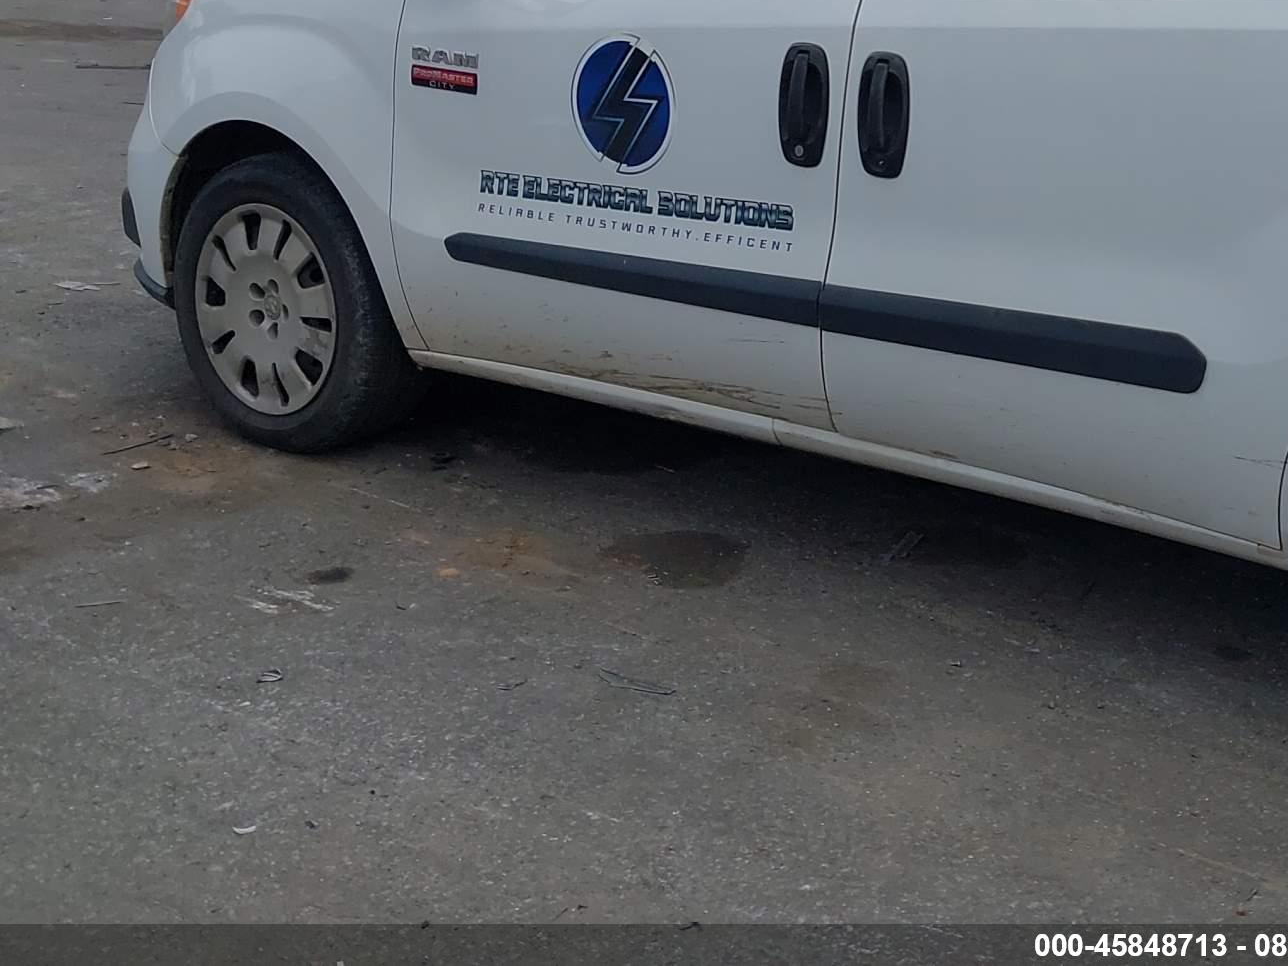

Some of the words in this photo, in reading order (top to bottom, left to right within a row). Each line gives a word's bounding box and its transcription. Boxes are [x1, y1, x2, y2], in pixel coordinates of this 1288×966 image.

[411, 46, 478, 69] RAM
[429, 80, 456, 90] CITY
[480, 170, 520, 197] RTE
[522, 175, 653, 214] ELECTRICAL
[657, 191, 794, 231] SOLUTIONS
[478, 203, 555, 222] RELIABLE
